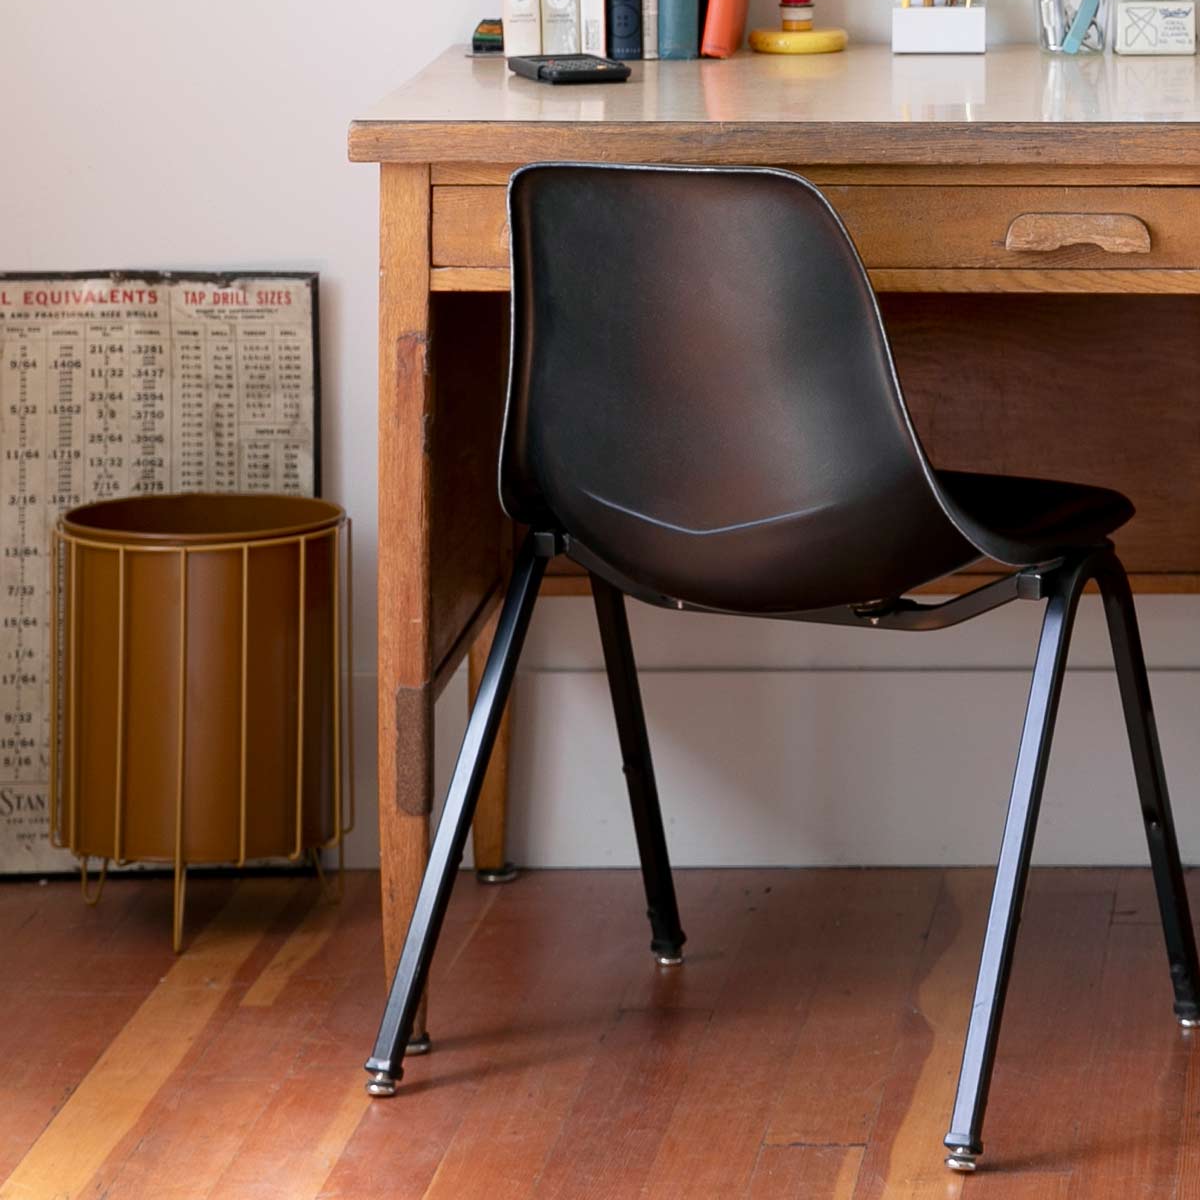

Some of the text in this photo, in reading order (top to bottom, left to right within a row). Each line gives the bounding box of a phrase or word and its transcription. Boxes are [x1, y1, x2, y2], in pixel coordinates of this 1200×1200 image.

[23, 290, 159, 305] EQUIVALENTS
[184, 290, 292, 305] TAP DRILL SIZES
